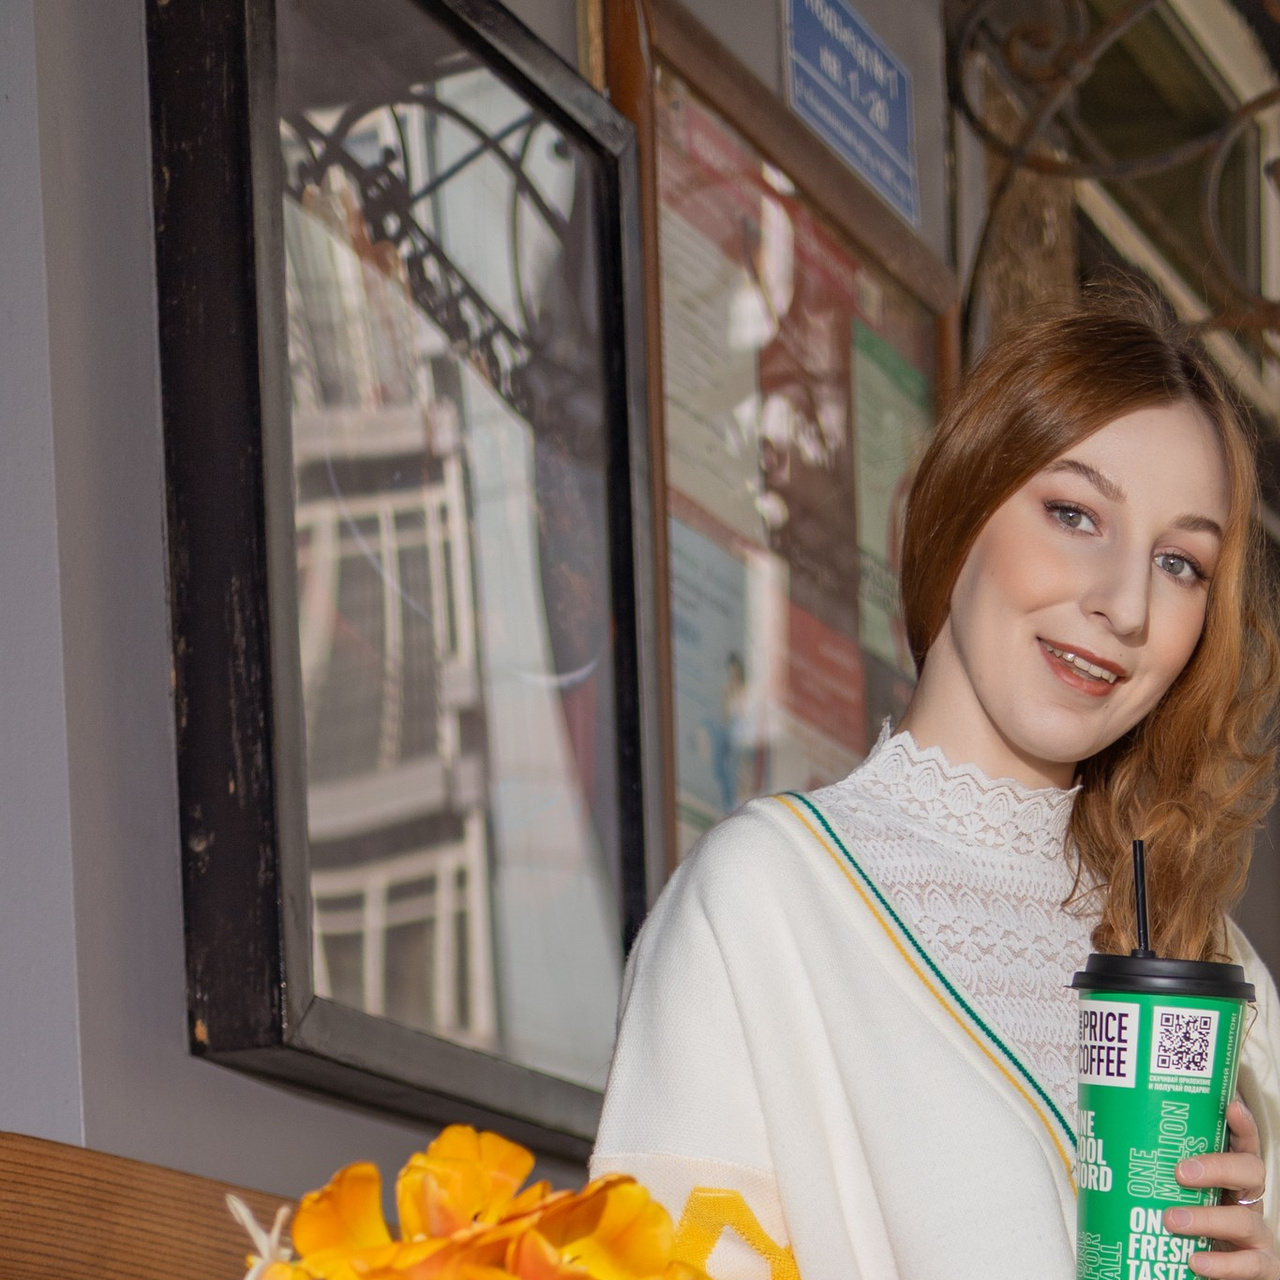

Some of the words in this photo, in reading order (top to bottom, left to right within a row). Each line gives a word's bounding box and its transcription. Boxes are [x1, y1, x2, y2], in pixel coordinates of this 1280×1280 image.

[1083, 1010, 1129, 1044] PRICE
[1218, 1067, 1230, 1115] ГОРЯЧИЙ
[1225, 1012, 1238, 1065] НАПИТОК!
[1154, 1083, 1183, 1092] ПОЛУЧАЙ
[1078, 1110, 1096, 1138] NE
[1078, 1136, 1107, 1166] OOL
[1153, 1100, 1190, 1202] MILLION
[1077, 1162, 1113, 1193] ORD
[1127, 1147, 1157, 1199] ONE
[1129, 1206, 1173, 1236] ON
[1084, 1232, 1101, 1280] FOR
[1128, 1232, 1195, 1264] FRESH
